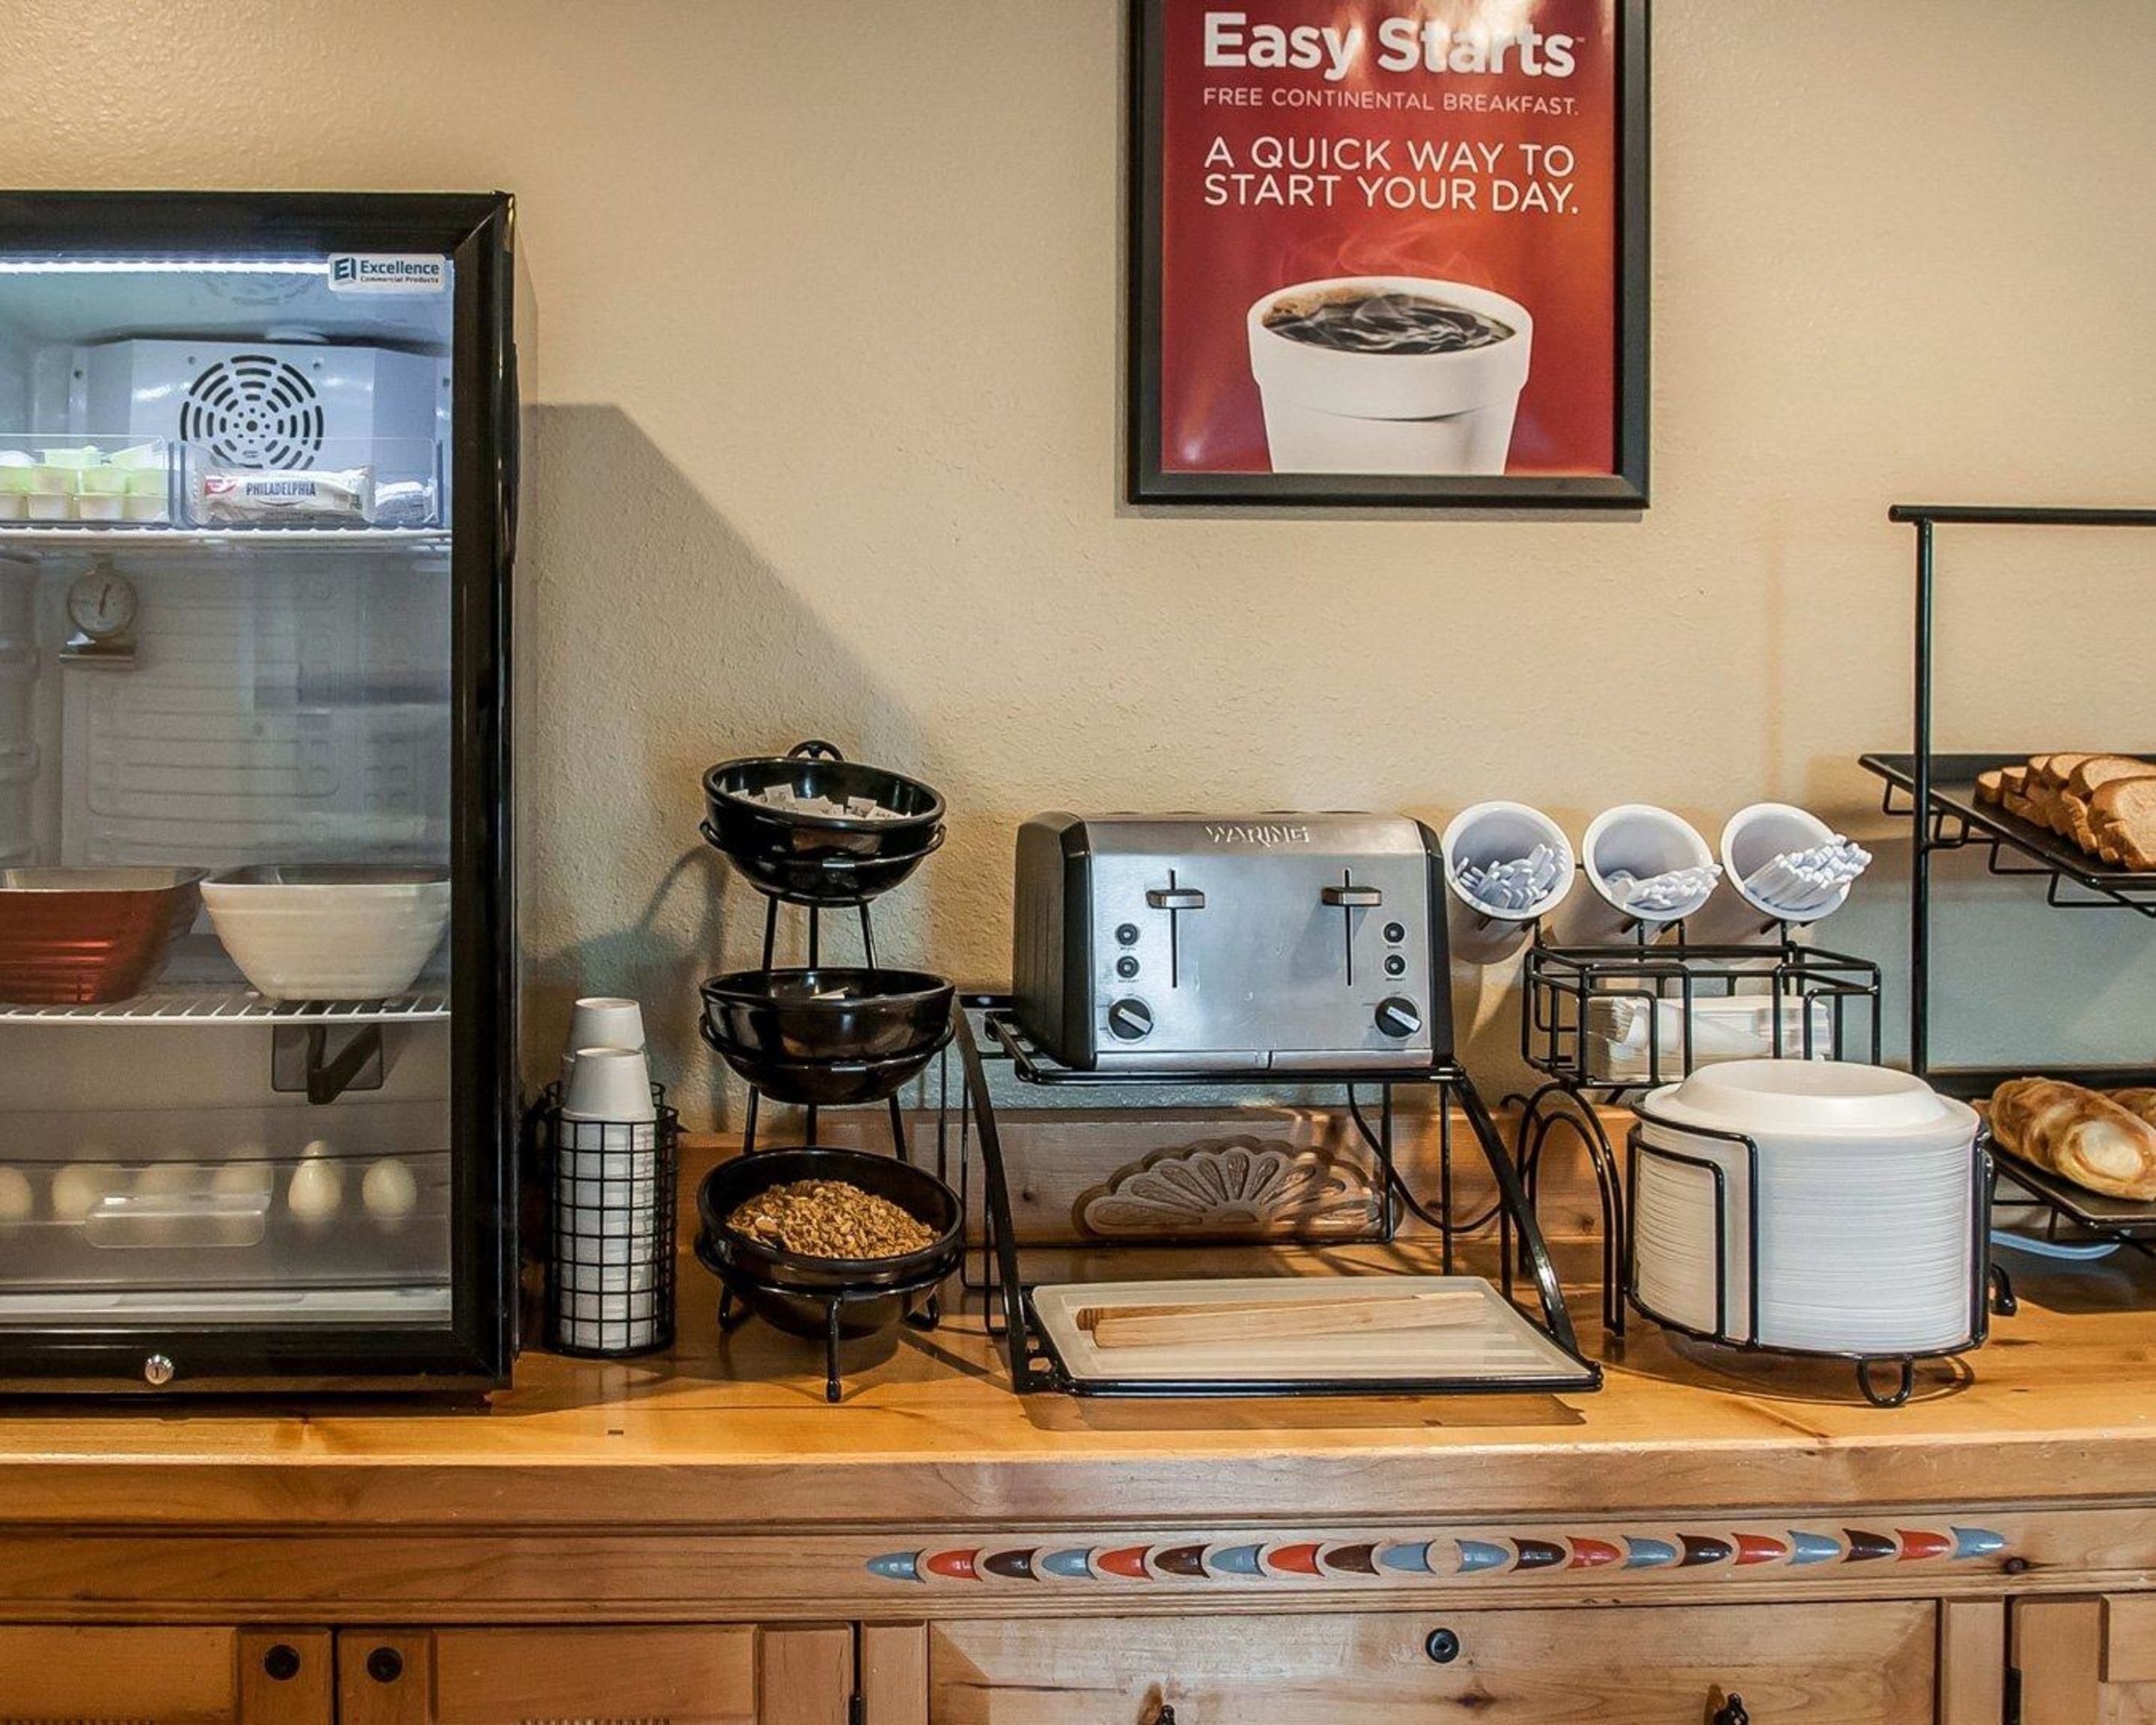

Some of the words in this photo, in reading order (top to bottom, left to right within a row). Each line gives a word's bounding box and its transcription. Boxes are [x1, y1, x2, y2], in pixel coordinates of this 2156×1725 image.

[1204, 11, 1363, 81] Easy
[1377, 16, 1576, 78] Starts
[1203, 87, 1263, 106] FREE
[1272, 88, 1435, 111] CONTINENTAL
[1443, 92, 1579, 116] BREAKFAST.
[1204, 136, 1234, 168] A
[1251, 136, 1392, 171] QUICK
[1407, 140, 1504, 174] WAY
[1518, 143, 1574, 177] TO
[1204, 174, 1342, 207] START
[1356, 176, 1476, 210] YOUR
[1493, 179, 1579, 214] DAY.
[360, 260, 439, 275] Excellence
[246, 481, 317, 496] PHILADELPHIA
